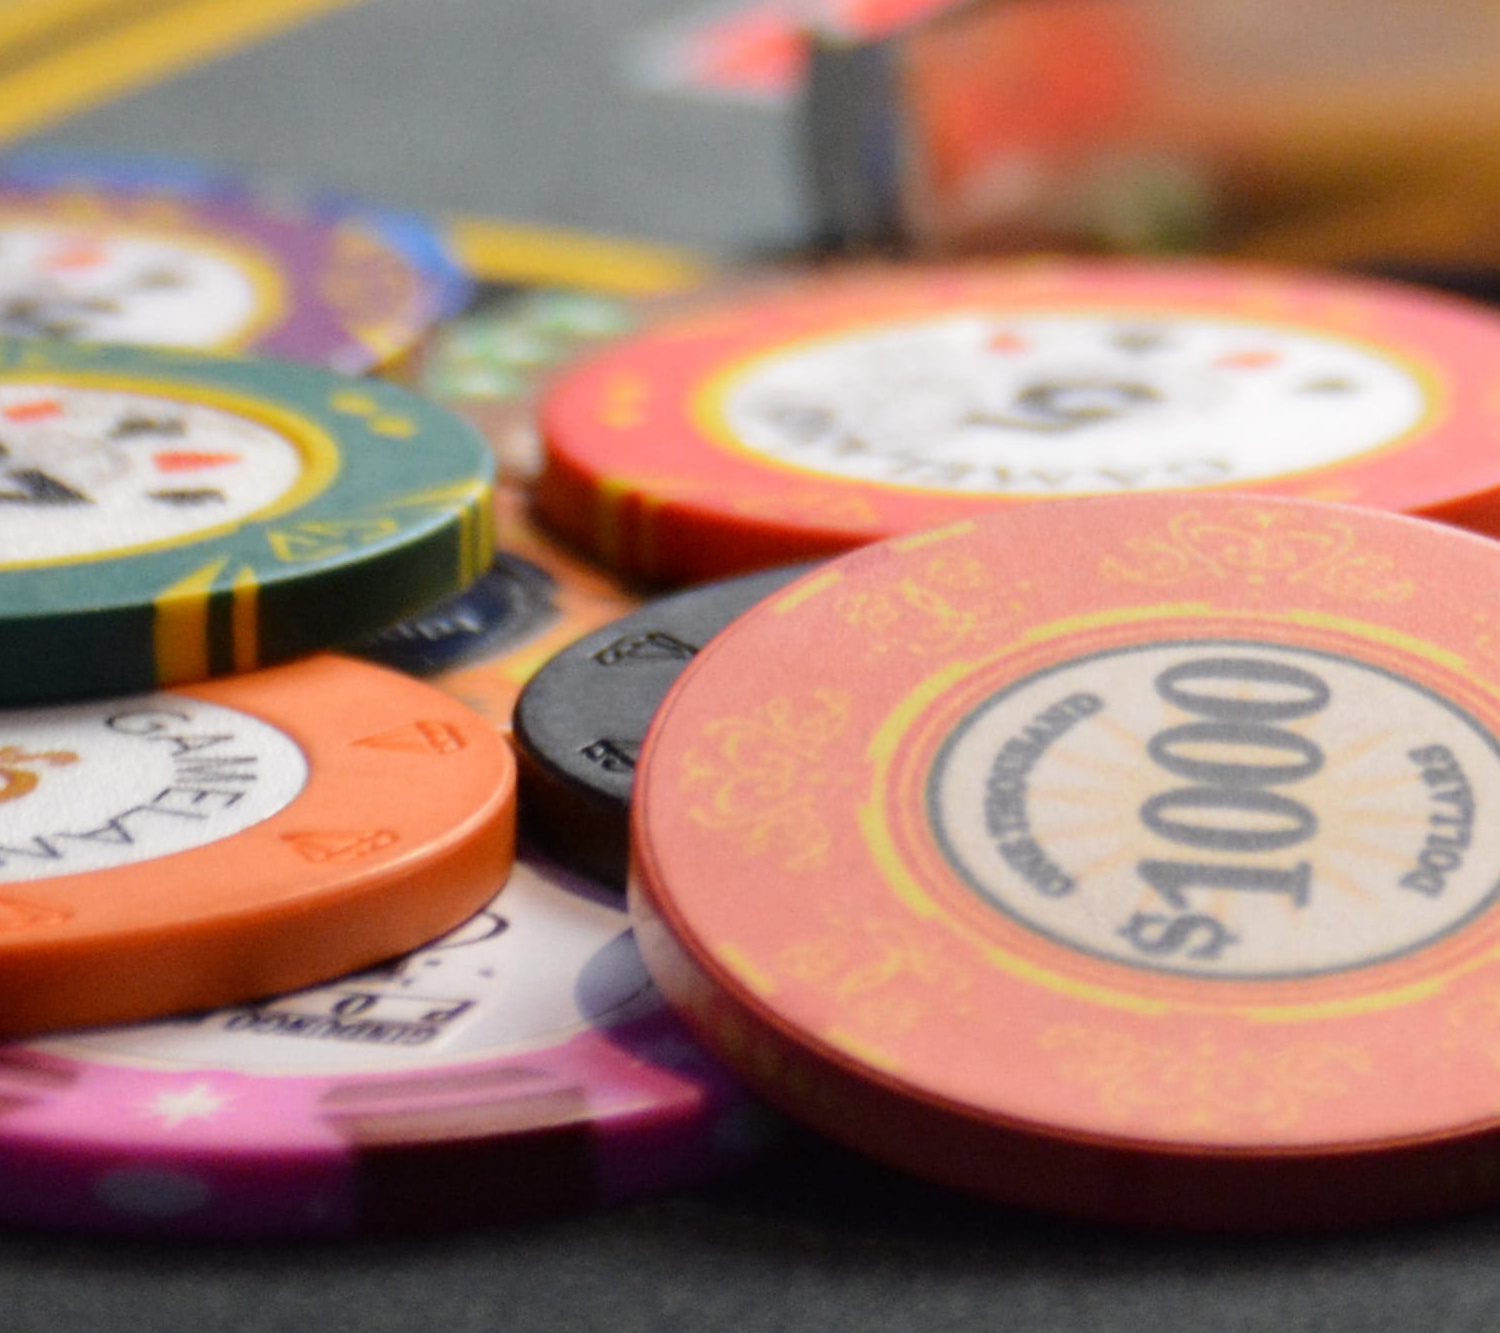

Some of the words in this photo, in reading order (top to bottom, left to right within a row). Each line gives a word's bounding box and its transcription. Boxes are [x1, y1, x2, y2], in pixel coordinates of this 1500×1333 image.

[984, 692, 1106, 840] THOUSAND
[1114, 658, 1331, 960] $1000
[1398, 741, 1476, 899] DOLLARS
[998, 836, 1076, 899] ONE
